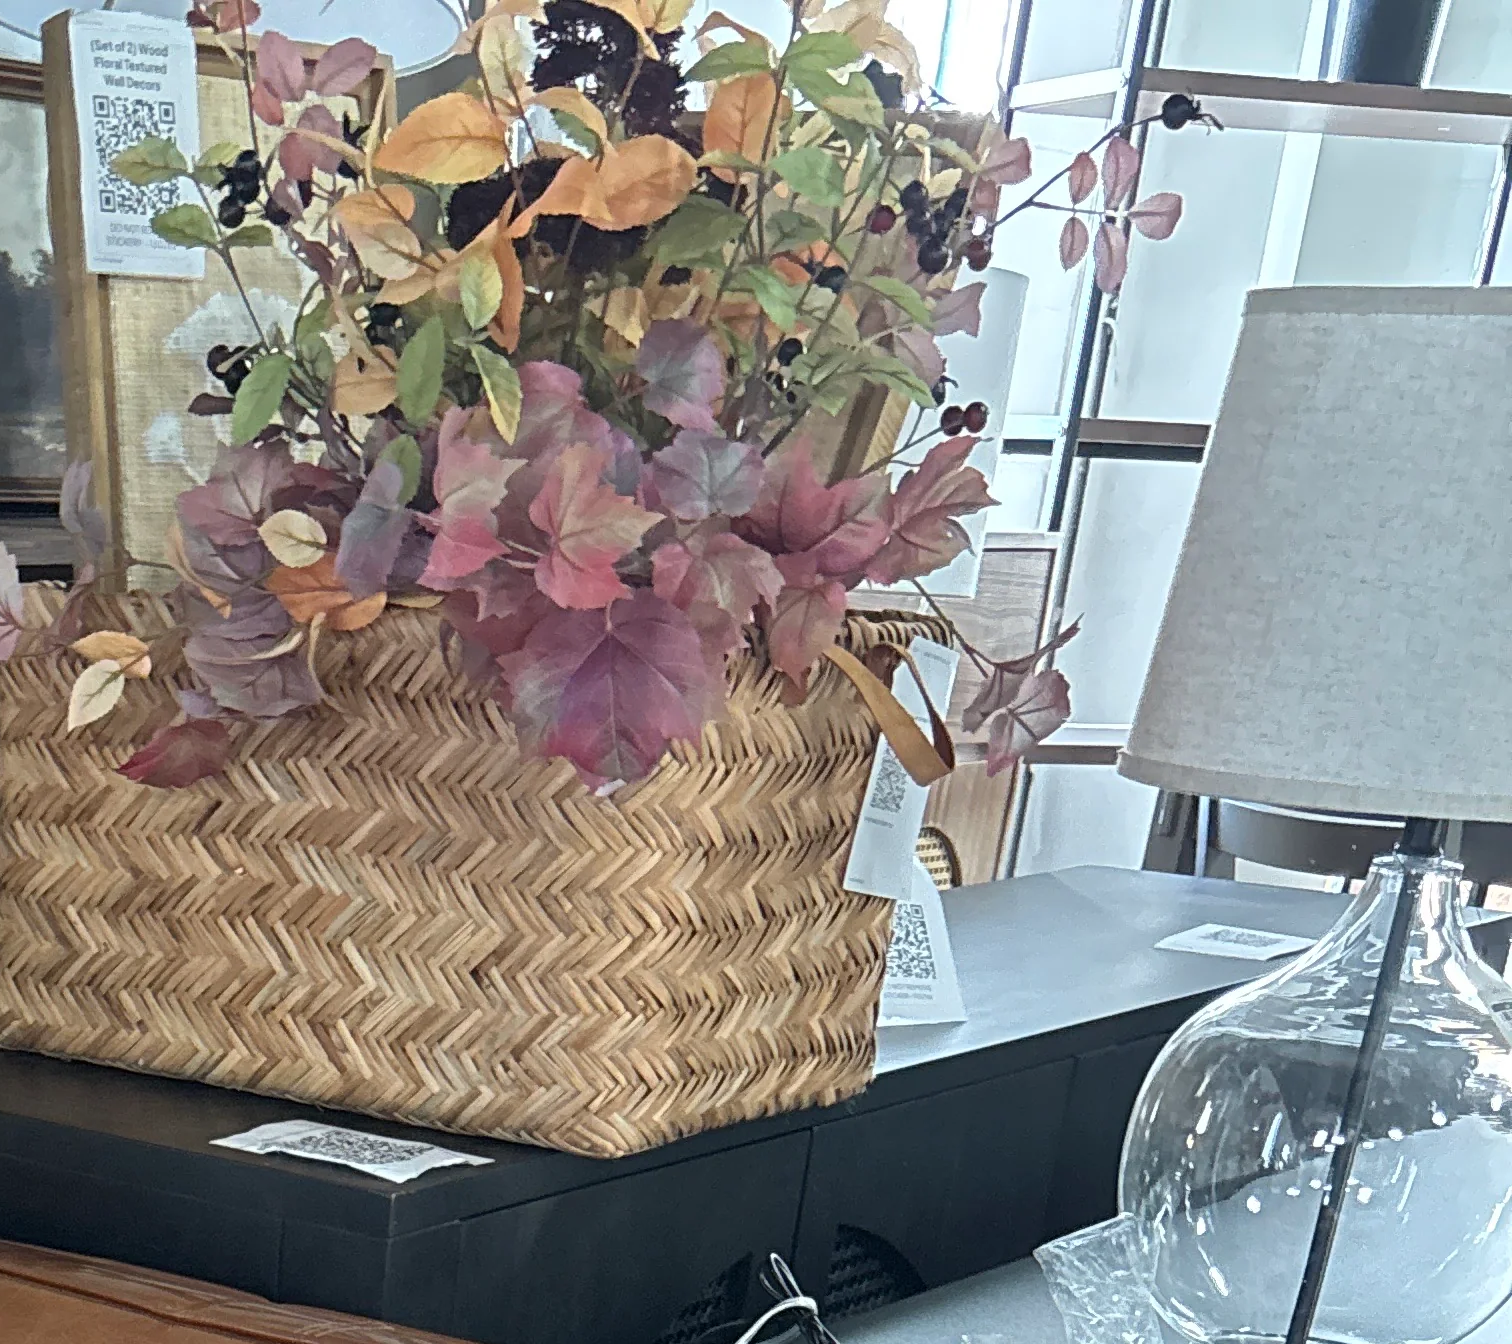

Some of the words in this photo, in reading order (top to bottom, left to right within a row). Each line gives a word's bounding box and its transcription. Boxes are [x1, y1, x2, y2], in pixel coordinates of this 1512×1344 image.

[139, 43, 168, 57] Wood
[124, 59, 167, 74] Textured
[103, 74, 124, 87] Wall
